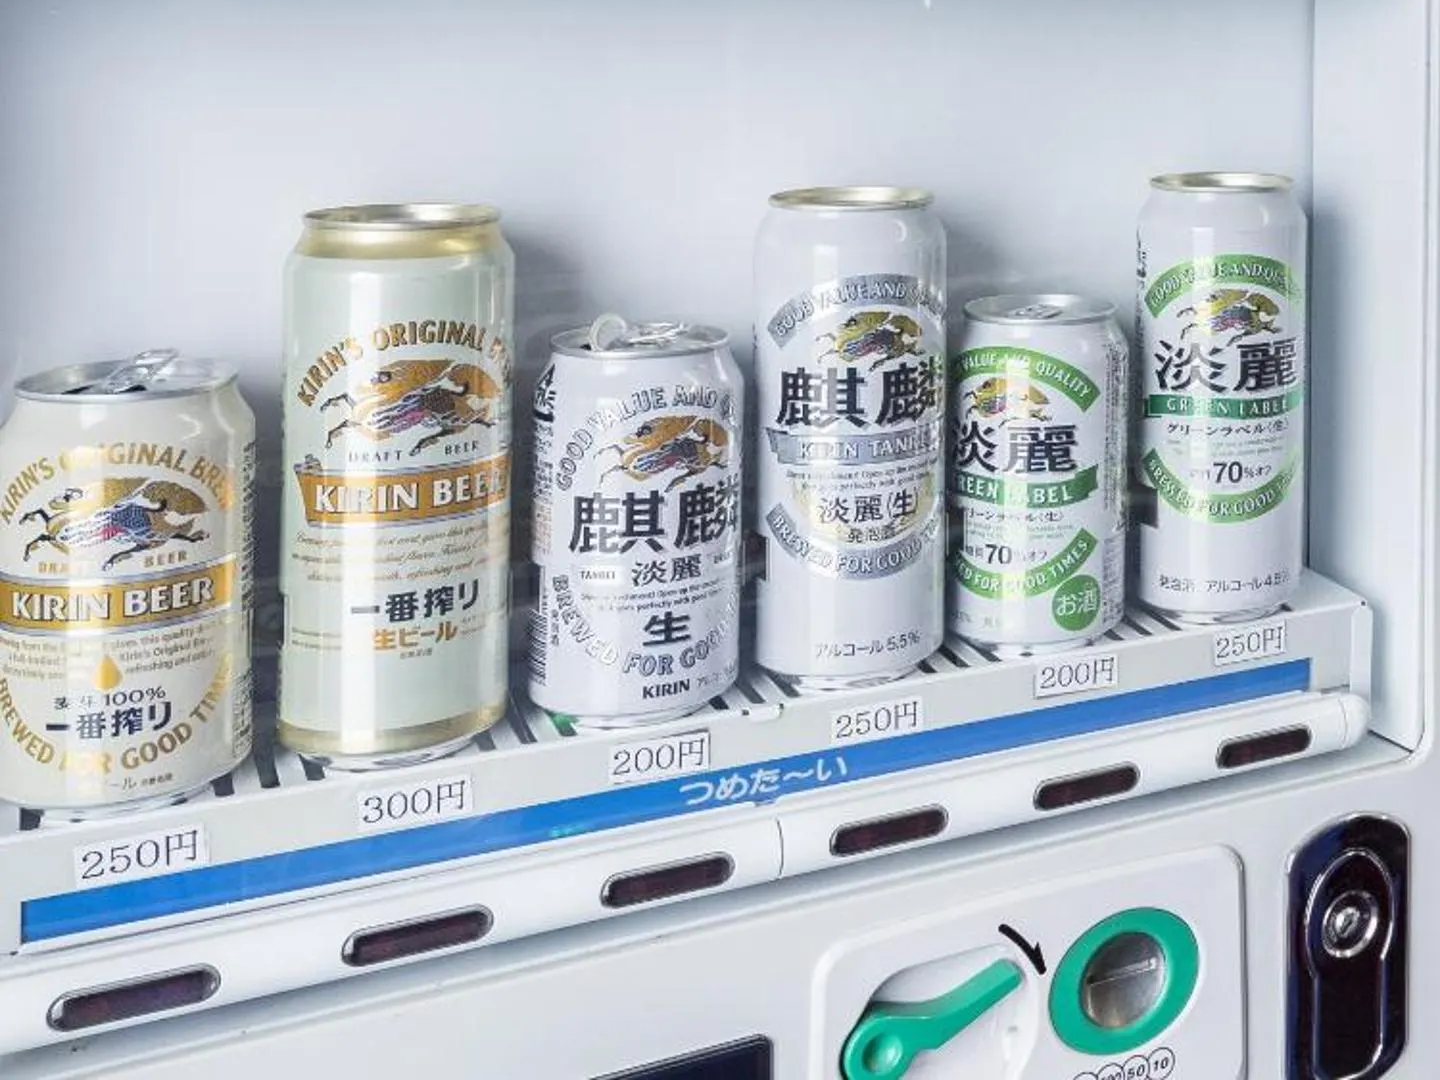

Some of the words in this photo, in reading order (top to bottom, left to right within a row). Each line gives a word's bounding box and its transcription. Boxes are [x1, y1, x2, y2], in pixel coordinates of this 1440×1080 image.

[296, 335, 364, 407] KIRIN'S
[371, 319, 487, 352] ORIGINAL
[1035, 360, 1092, 398] QUALITY
[1153, 336, 1297, 393] 淡麗
[1239, 399, 1289, 416] LABEL
[59, 442, 189, 472] OGINAL
[348, 449, 403, 463] DRAFT
[444, 440, 480, 456] BEER
[315, 482, 419, 513] KIRIN
[431, 468, 504, 508] BEER
[957, 474, 999, 499] REEN
[143, 550, 189, 569] BEER
[631, 553, 703, 588] 淡麗
[836, 554, 873, 572] FOR
[1047, 538, 1089, 577] TIMES
[12, 588, 112, 622] KIRIN
[122, 576, 216, 620] BEER
[351, 578, 480, 623] 一番搾り
[1056, 587, 1097, 617] お酒
[372, 620, 459, 651] 生ビール
[642, 611, 692, 646] 生
[1215, 624, 1285, 659] 250円
[153, 640, 192, 657] Original
[621, 651, 674, 677] FOR
[642, 677, 692, 700] KIRIN
[1039, 658, 1115, 691] 200円
[45, 700, 172, 739] 一番搾り
[835, 700, 919, 741] 250円
[120, 721, 193, 770] GOOD
[612, 735, 706, 776] 200円
[362, 778, 467, 824] 300円
[80, 828, 200, 881] 250円
[1127, 1063, 1146, 1080] 50
[1153, 1056, 1170, 1072] 10
